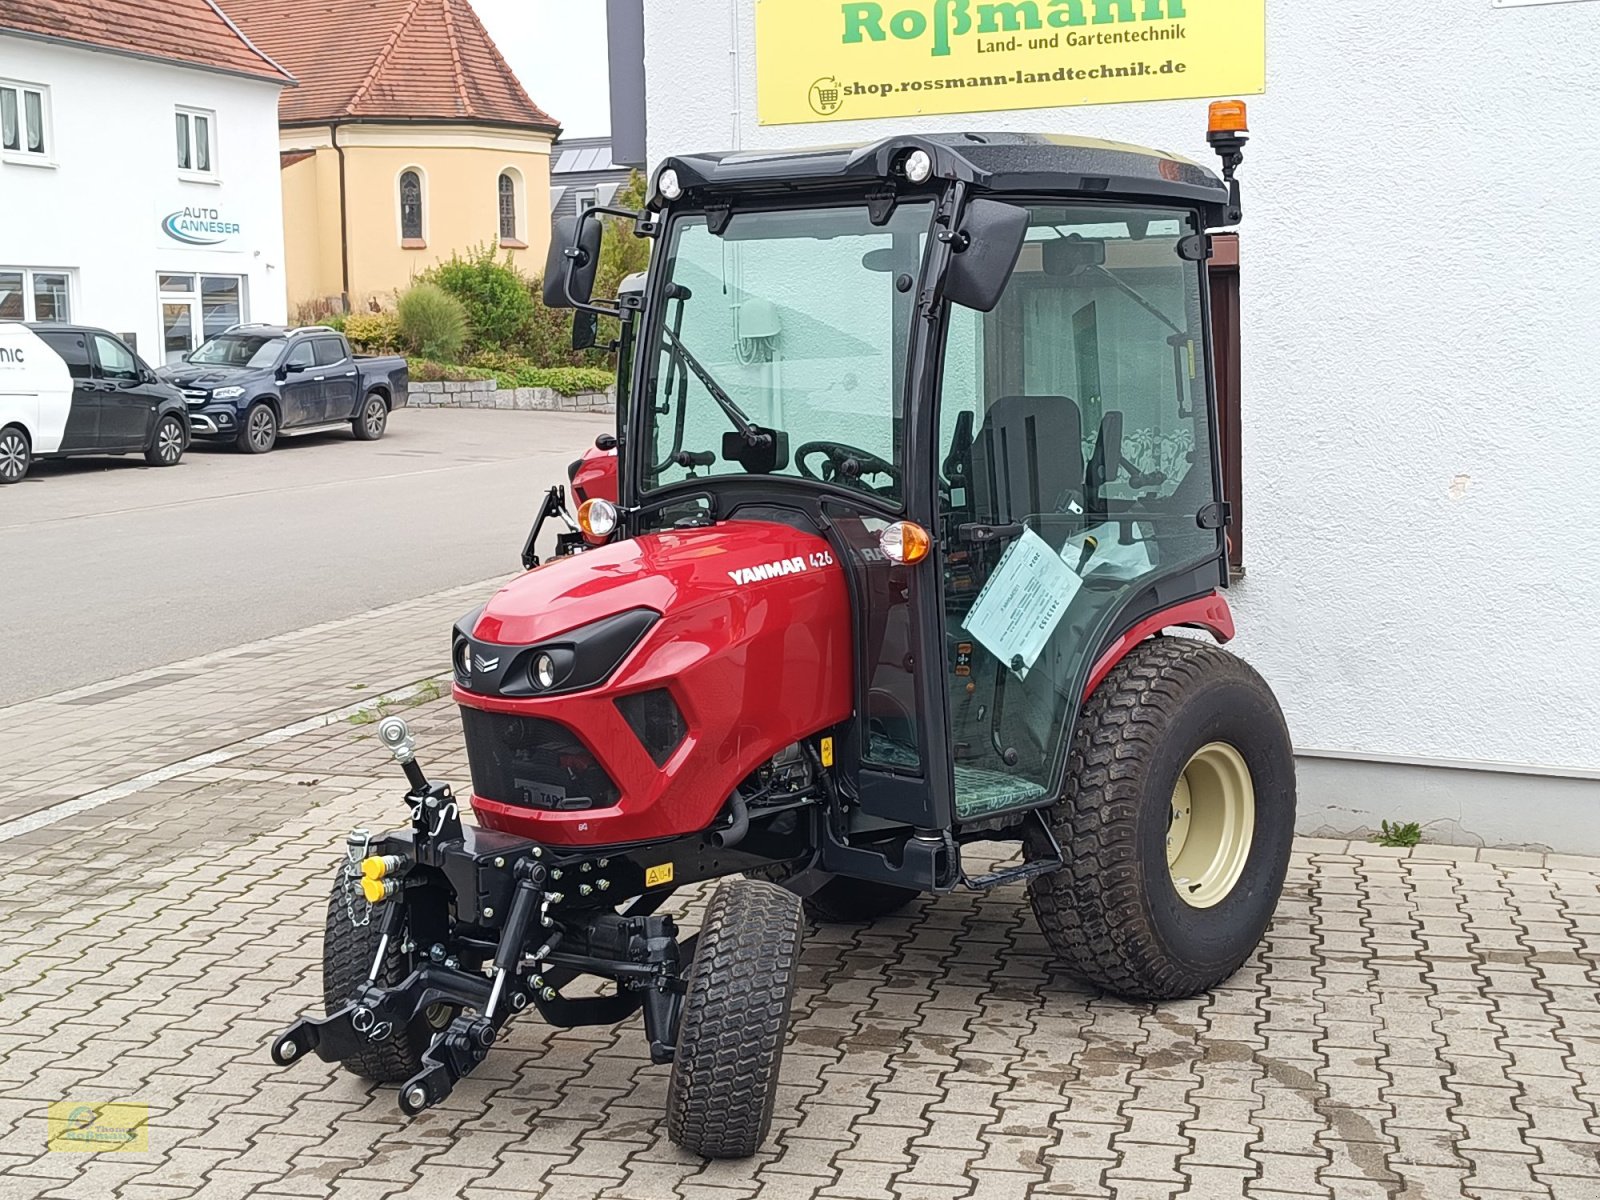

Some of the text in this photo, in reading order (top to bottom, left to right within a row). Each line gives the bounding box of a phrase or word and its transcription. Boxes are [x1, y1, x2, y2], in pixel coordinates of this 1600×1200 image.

[841, 0, 1187, 57] Roßmann
[977, 24, 1186, 53] Land- und Gartentechnik
[843, 60, 1187, 97] shop.rossmann-landtechnik.de
[180, 219, 241, 234] ANNESER
[183, 206, 219, 220] AUTO
[728, 556, 807, 586] YANMAR
[808, 550, 834, 568] 426
